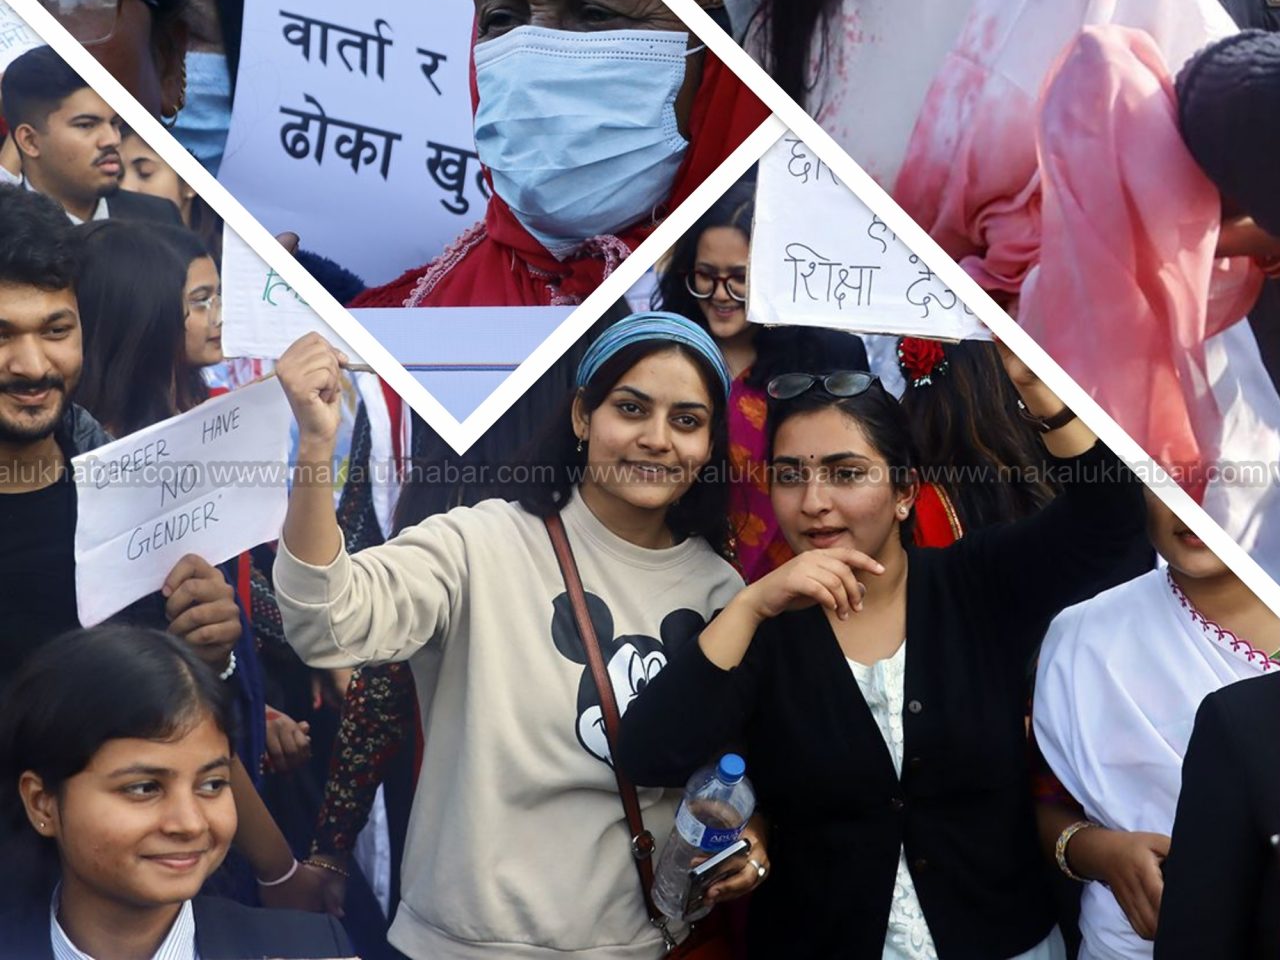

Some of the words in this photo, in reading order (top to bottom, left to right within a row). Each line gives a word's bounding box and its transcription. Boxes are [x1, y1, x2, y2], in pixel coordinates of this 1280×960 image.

[279, 9, 393, 82] वार्ता
[416, 47, 447, 96] र
[279, 93, 402, 181] ढोका
[784, 243, 881, 310] शिक्षा
[202, 406, 241, 444] HAVE
[161, 464, 198, 507] NO
